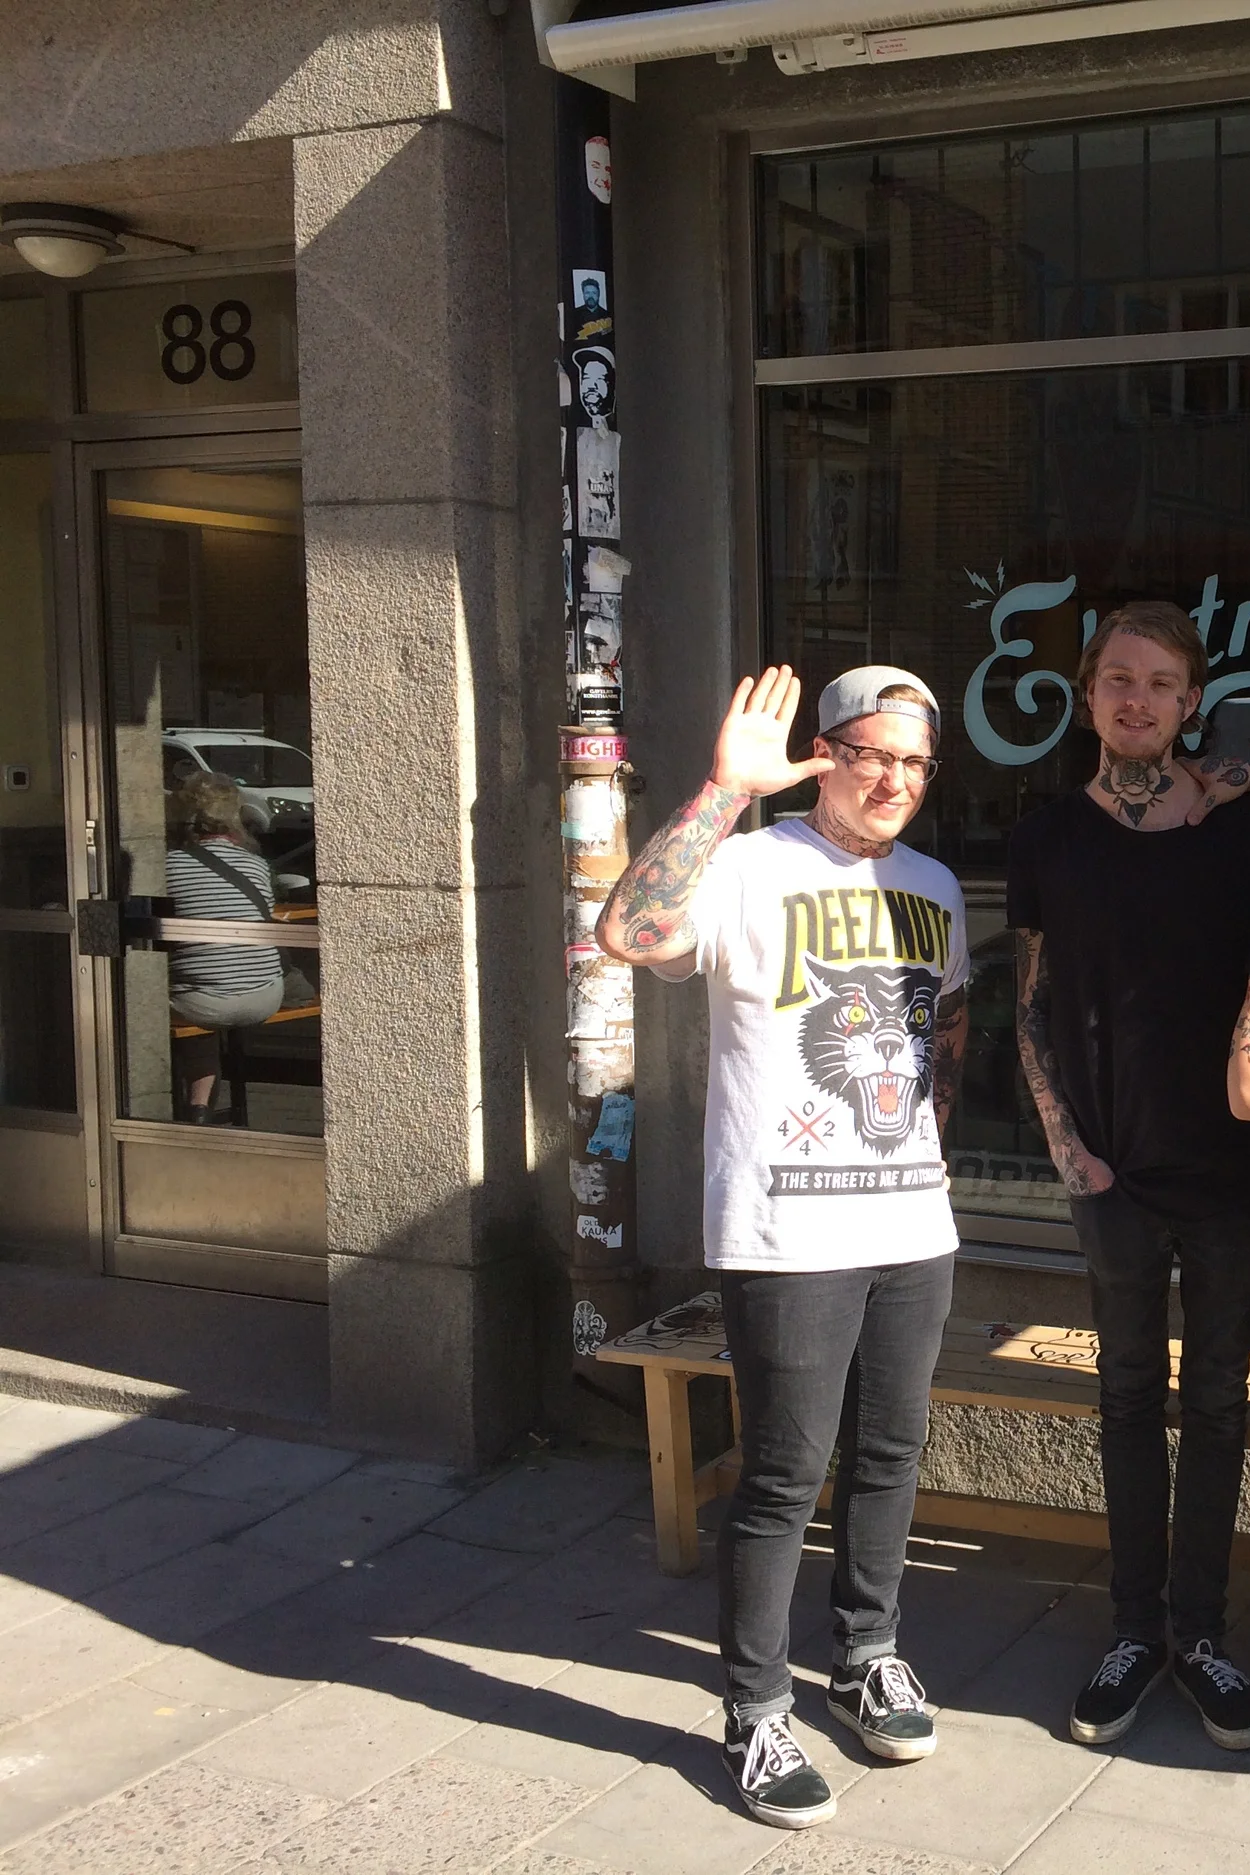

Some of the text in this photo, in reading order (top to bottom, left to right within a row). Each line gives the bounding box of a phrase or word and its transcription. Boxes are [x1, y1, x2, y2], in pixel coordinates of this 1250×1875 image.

[162, 300, 255, 384] 88
[775, 888, 887, 1009] DEEZ
[778, 1120, 835, 1137] 4 2
[799, 1140, 811, 1156] 4
[780, 1172, 810, 1189] THE
[814, 1172, 876, 1189] STREETS
[879, 1171, 898, 1187] ARE
